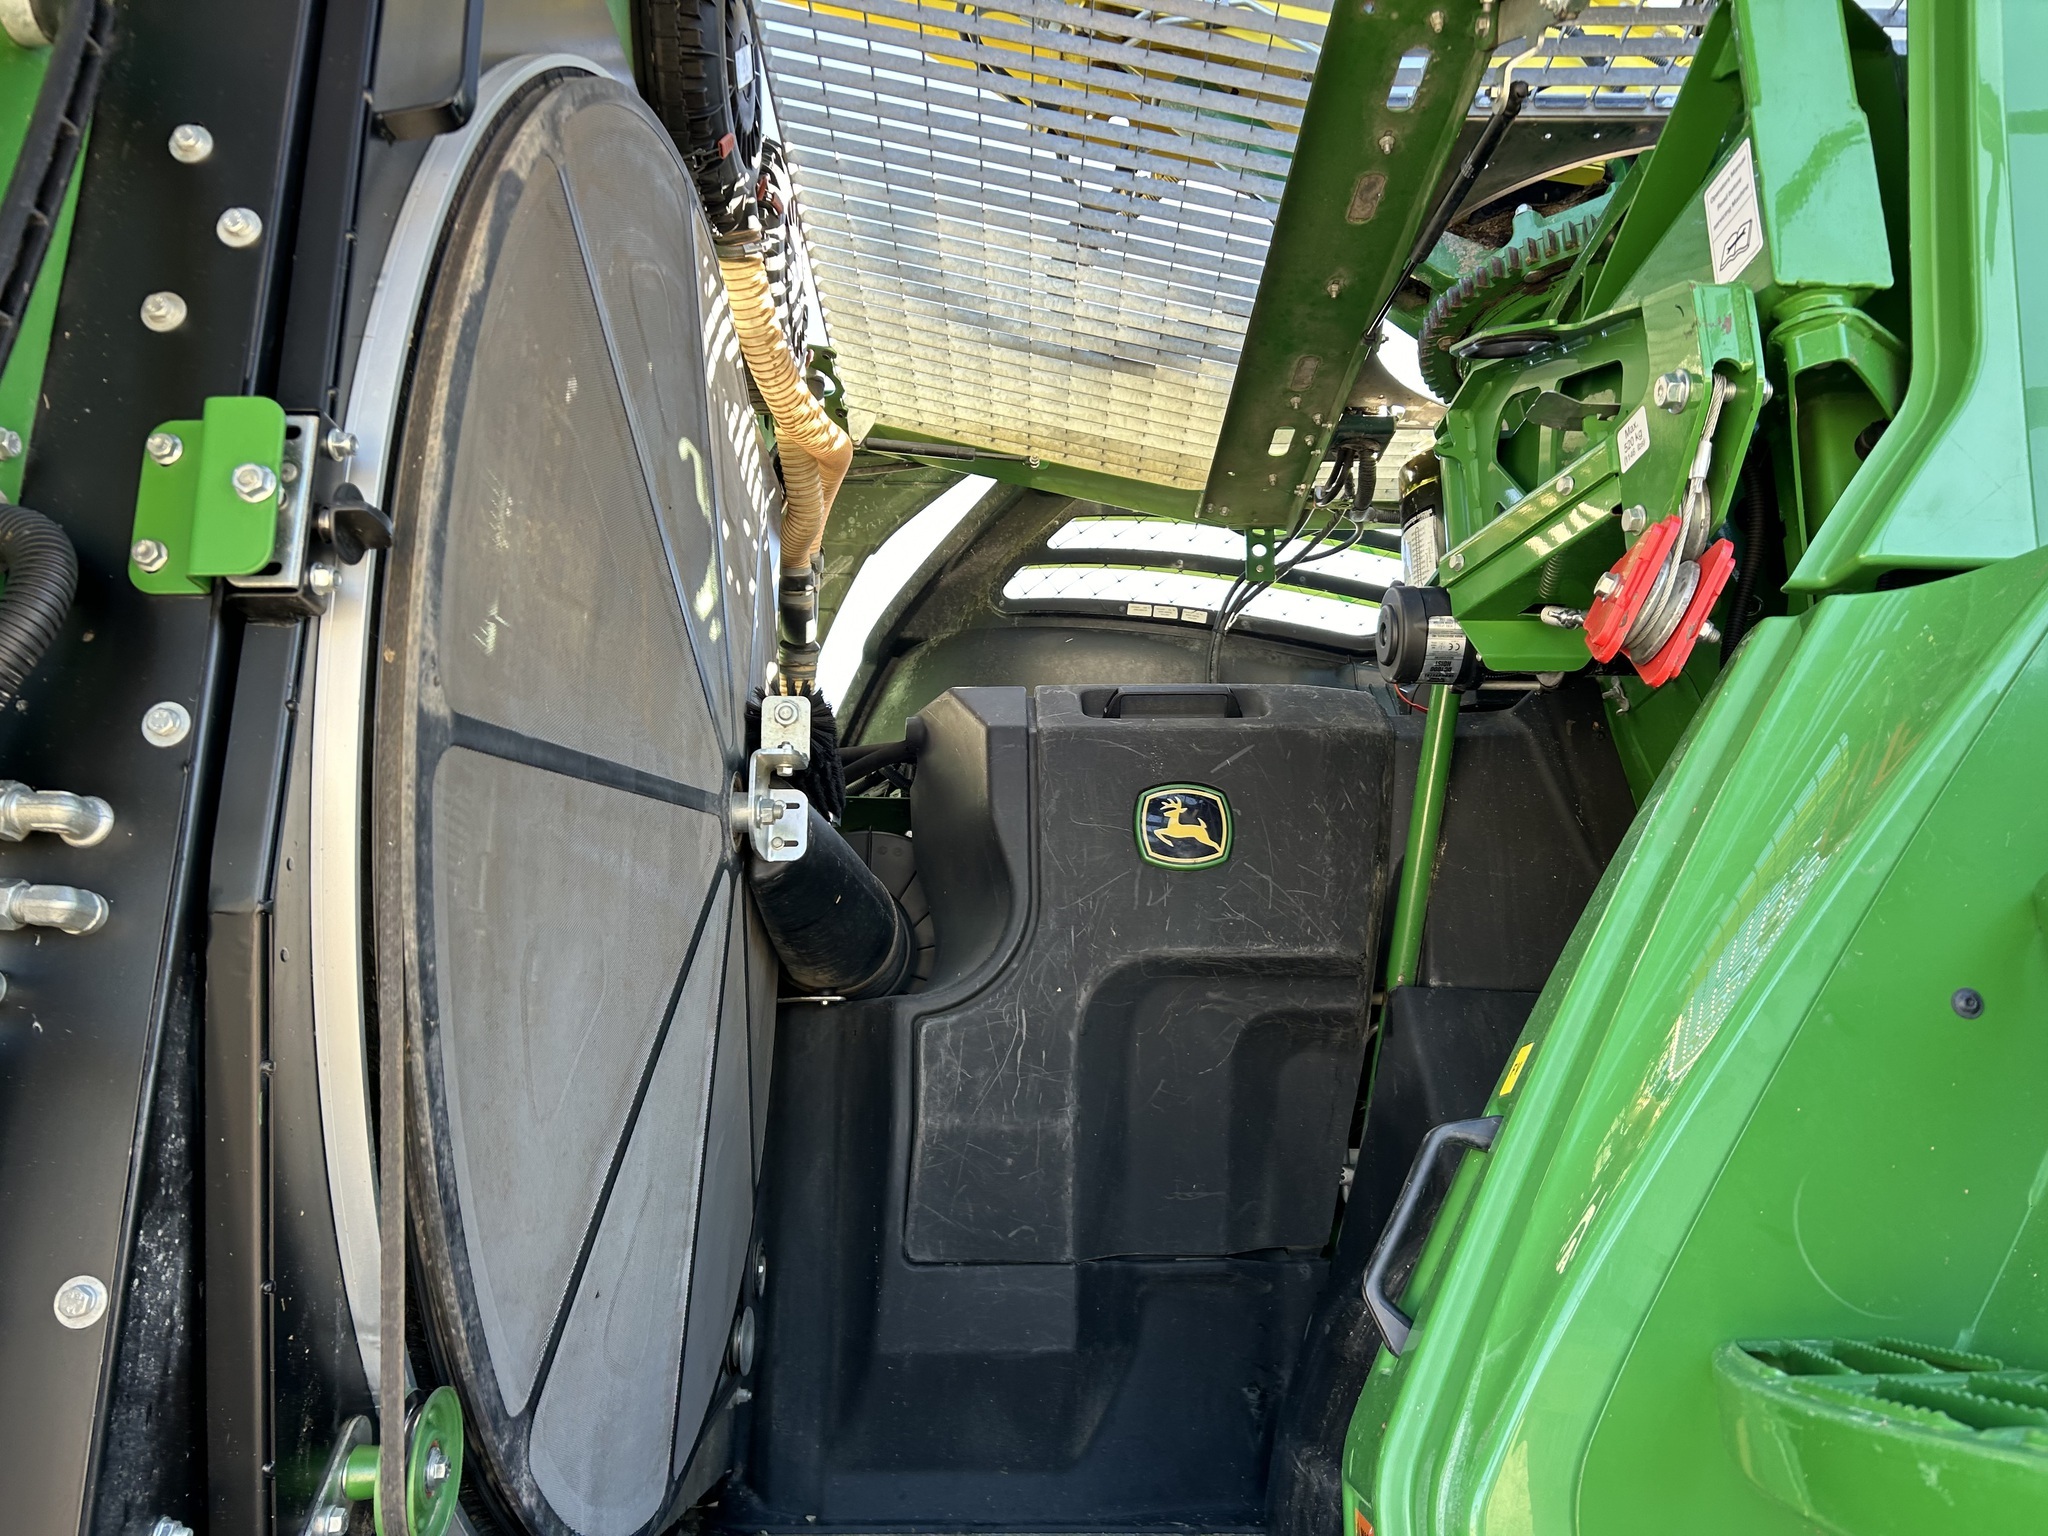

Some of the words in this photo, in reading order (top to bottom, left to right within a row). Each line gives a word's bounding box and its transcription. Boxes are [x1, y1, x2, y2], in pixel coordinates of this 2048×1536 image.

[1731, 155, 1746, 177] Manual
[1717, 193, 1728, 211] Read
[1728, 177, 1741, 196] before
[1732, 183, 1749, 207] Machine
[1623, 436, 1635, 453] 520
[1635, 429, 1643, 442] kg
[1624, 421, 1639, 439] Max.
